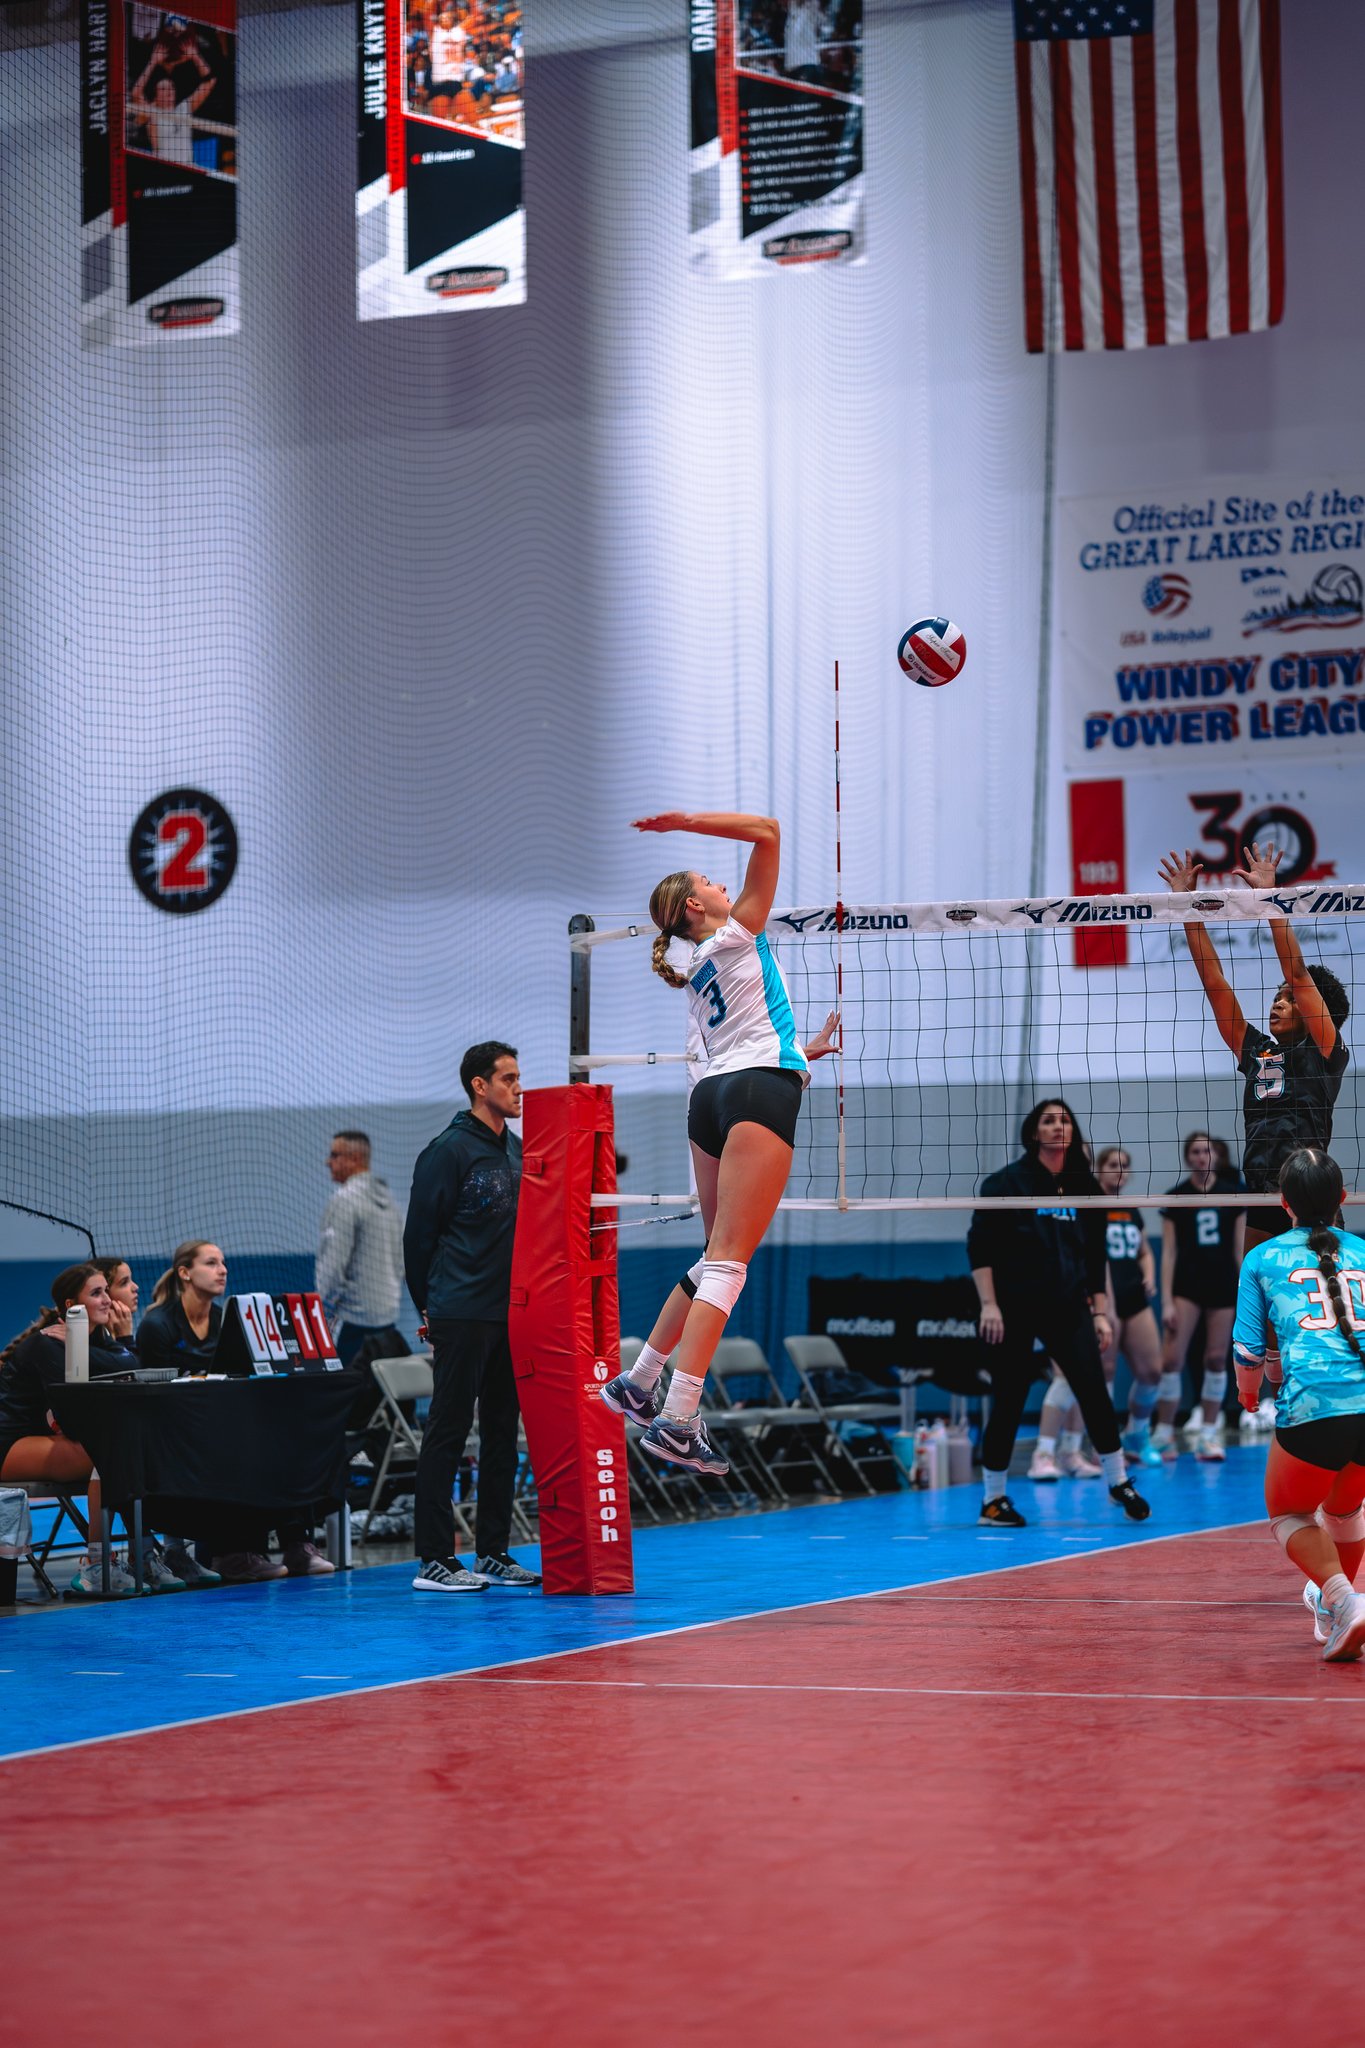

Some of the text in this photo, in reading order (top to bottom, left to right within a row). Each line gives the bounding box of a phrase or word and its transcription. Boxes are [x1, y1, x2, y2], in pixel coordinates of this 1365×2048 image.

[88, 58, 108, 136] JACLYN
[363, 58, 388, 120] JULIE
[1113, 487, 1365, 534] Official Site of the
[1080, 520, 1365, 571] GREAT LAKES REGI
[1116, 650, 1365, 702] WINDY CITY
[1084, 705, 1239, 750] POWER
[158, 809, 209, 894] 2
[702, 979, 728, 1029] 3
[1253, 1052, 1286, 1101] 5
[1196, 1209, 1219, 1245] 2
[245, 1303, 283, 1352] 14
[276, 1301, 289, 1326] 2
[293, 1299, 332, 1351] 11
[826, 1317, 895, 1336] molten
[596, 1448, 619, 1543] senoh
